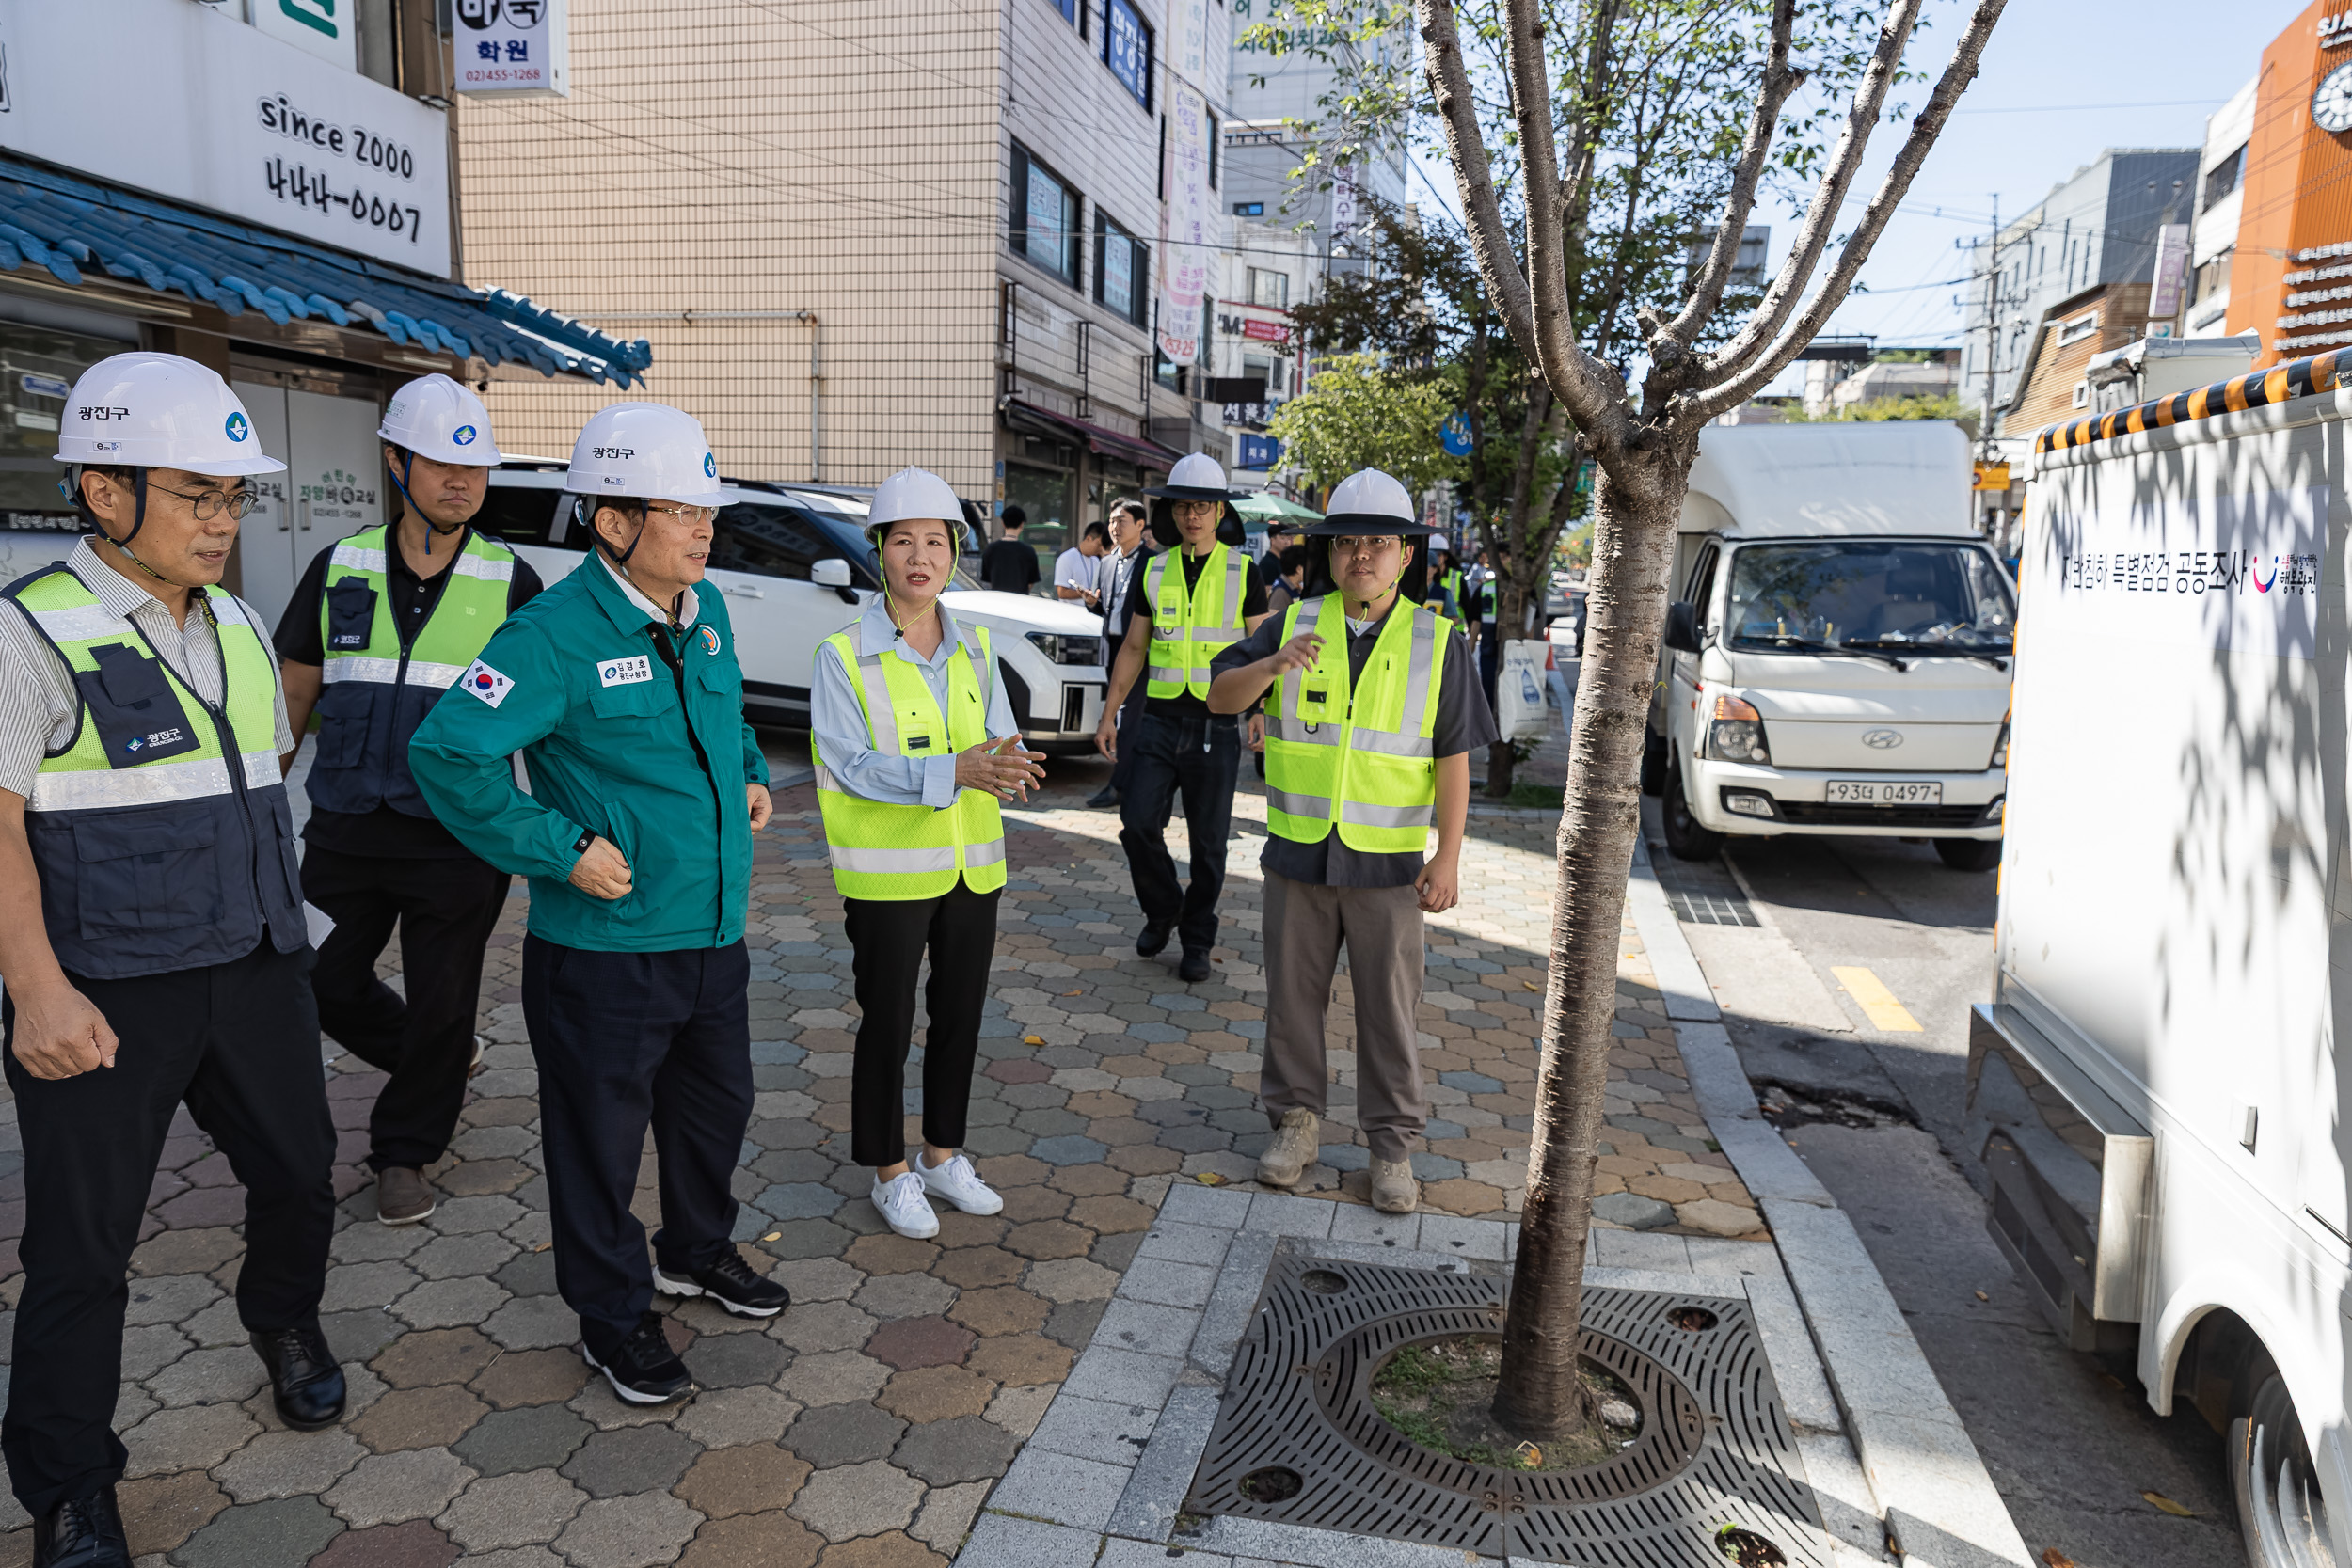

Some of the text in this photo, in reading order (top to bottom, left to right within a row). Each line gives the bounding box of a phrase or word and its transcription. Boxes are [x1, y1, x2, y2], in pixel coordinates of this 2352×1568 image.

[477, 40, 529, 63] 학원
[465, 69, 542, 82] 02)455-1268
[262, 97, 413, 179] since 2000
[265, 157, 420, 243] 444-0007
[78, 406, 131, 420] 광진구
[592, 447, 636, 460] 광진구
[2113, 552, 2170, 592] 특별점검
[2176, 549, 2248, 595] 공동조사
[2280, 568, 2317, 595] 행복광진
[617, 659, 646, 672] 김경호
[619, 670, 647, 680] 광진구청장
[147, 728, 181, 743] 광진구
[1837, 784, 1931, 801] 93더 0497
